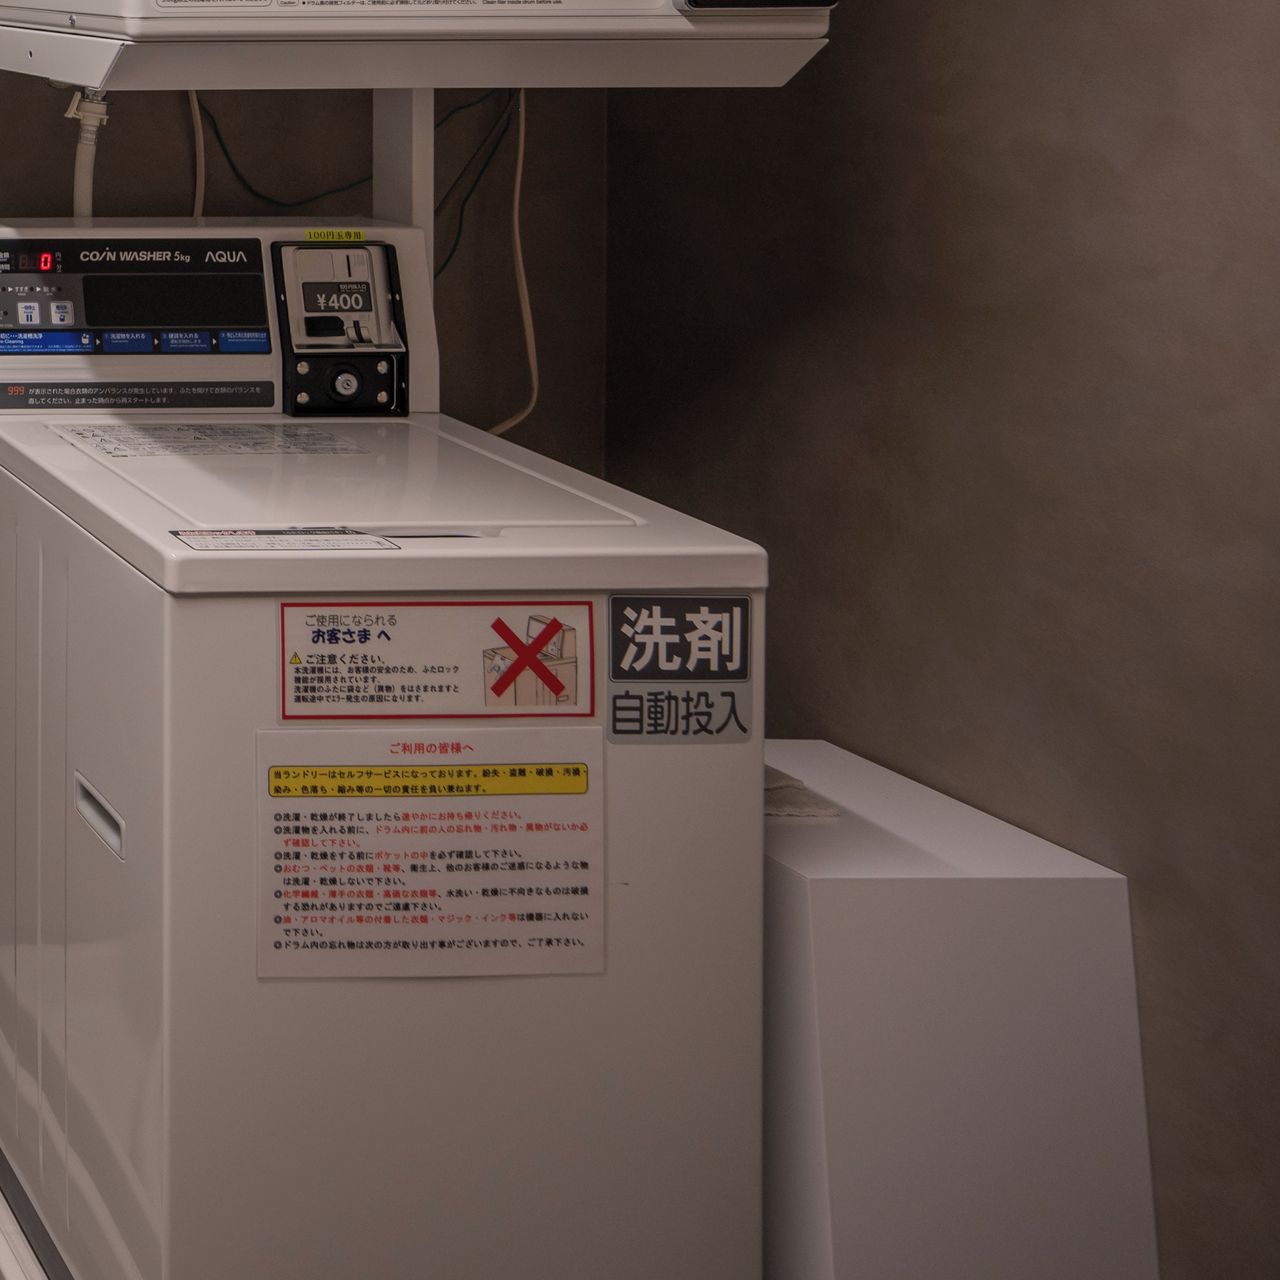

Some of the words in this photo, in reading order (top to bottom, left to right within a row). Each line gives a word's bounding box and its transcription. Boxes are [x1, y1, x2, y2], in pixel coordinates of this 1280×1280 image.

[309, 229, 361, 240] 100円玉専用
[39, 253, 52, 269] 0
[80, 248, 116, 261] COIN
[118, 249, 173, 262] WASHER
[174, 251, 190, 262] 5kg
[205, 251, 247, 262] AQUA
[317, 292, 362, 311] ¥400
[8, 385, 26, 396] 999
[306, 615, 396, 627] ご使用になられる
[617, 605, 744, 674] 洗剤
[307, 654, 386, 664] ご注意ください。
[613, 691, 747, 735] 自動投入
[389, 743, 473, 754] ご利用の皆様へ
